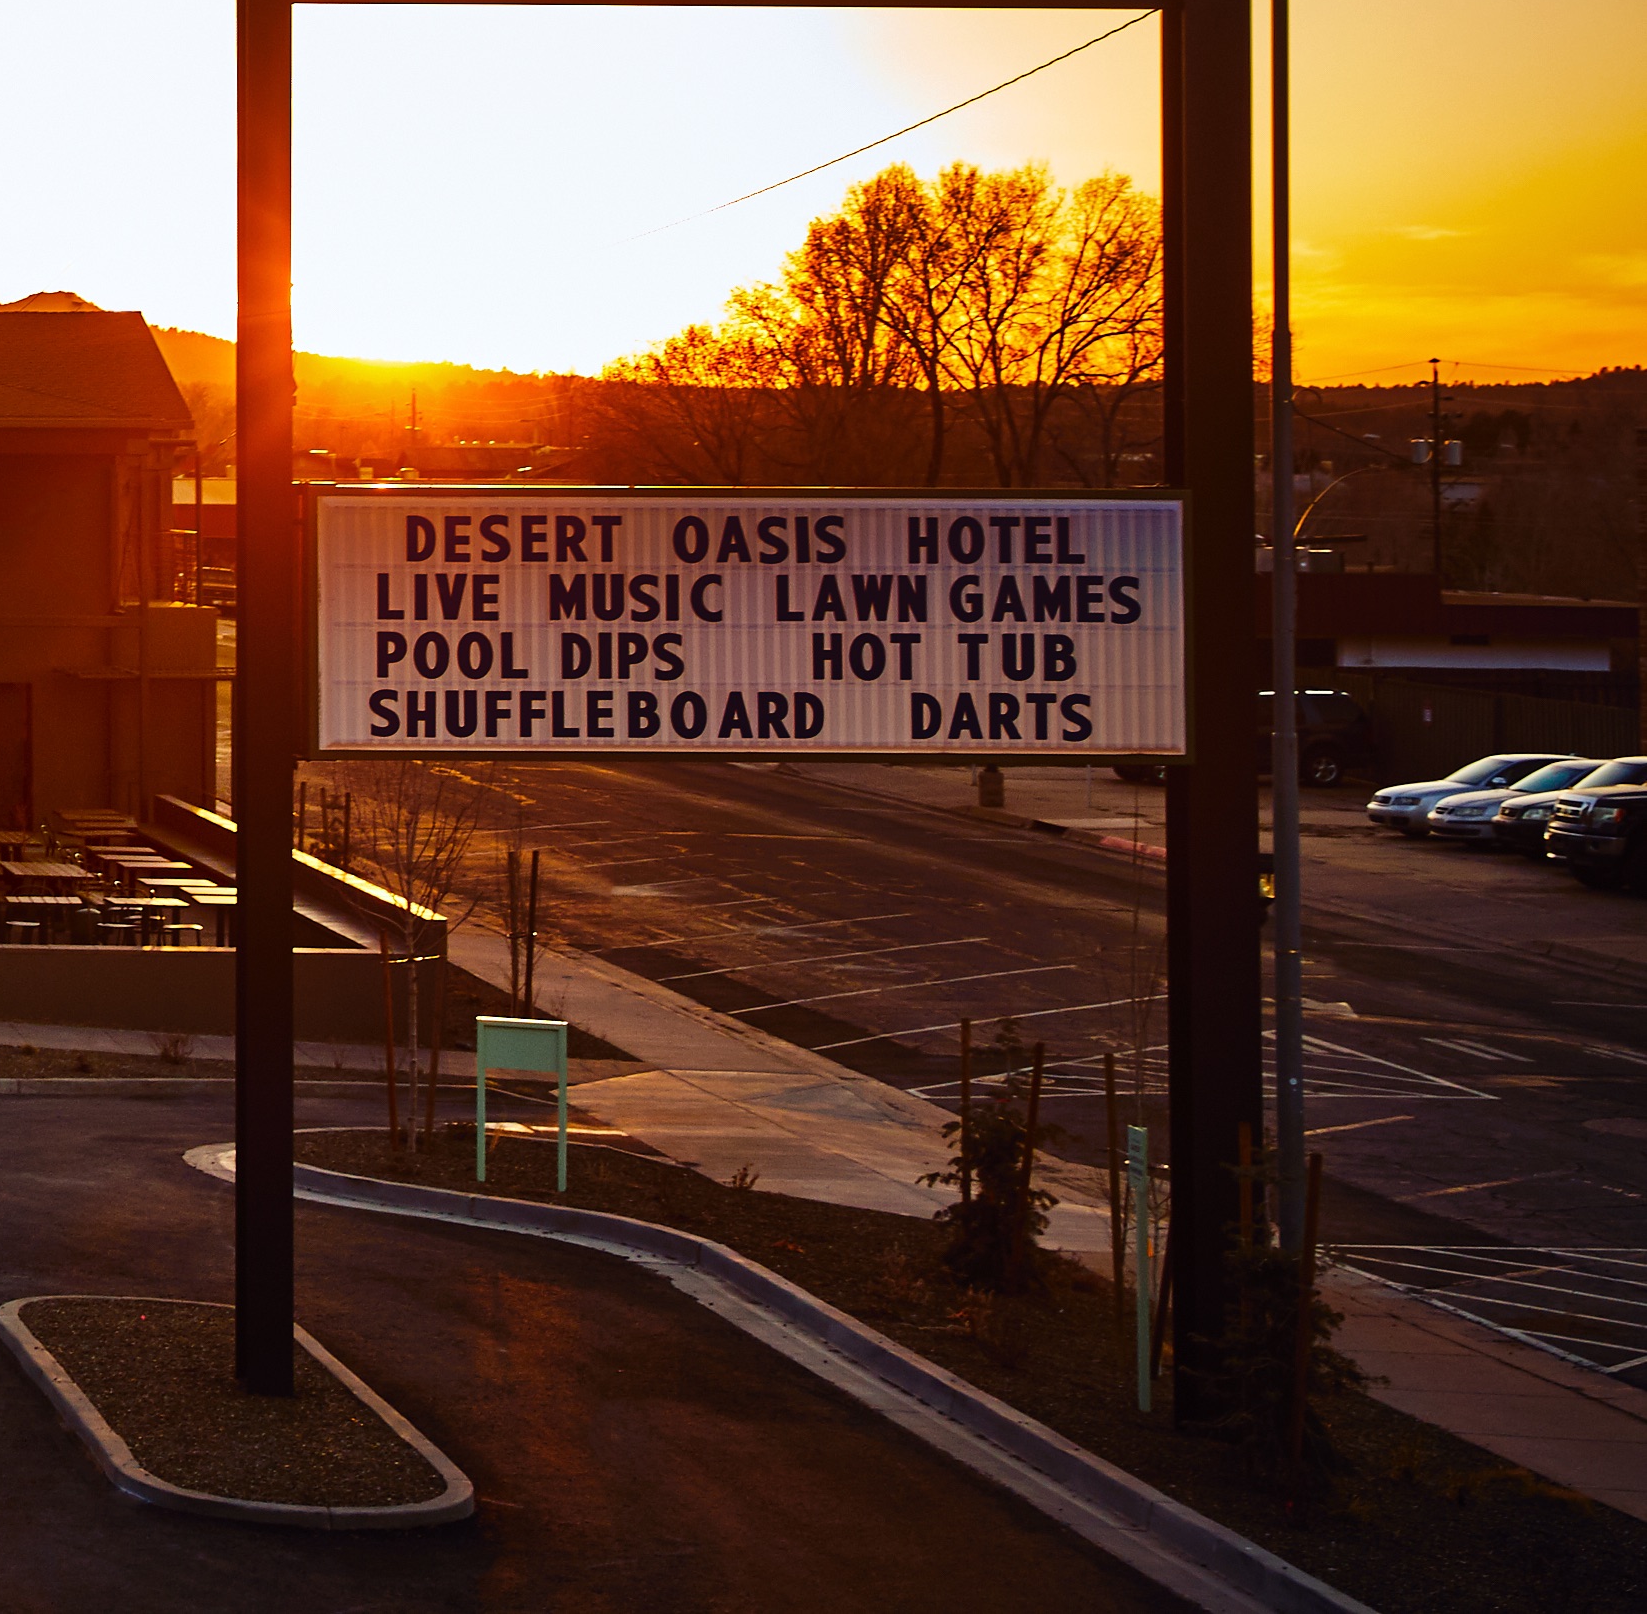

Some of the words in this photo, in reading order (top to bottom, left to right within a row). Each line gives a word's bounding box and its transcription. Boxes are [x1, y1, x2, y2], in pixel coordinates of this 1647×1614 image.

[405, 514, 623, 564] DESERT
[672, 514, 848, 564] OASIS
[907, 515, 1086, 565] HOTEL
[376, 572, 500, 622] LIVE
[548, 573, 724, 623] MUSIC
[775, 573, 928, 623] LAWN
[948, 574, 1142, 625] GAMES
[376, 631, 529, 680] POOL
[560, 631, 685, 682] DIPS
[811, 632, 922, 682] HOT
[957, 632, 1078, 682] TUB
[368, 688, 825, 740] SHUFFLEBOARD
[910, 692, 1093, 743] DARTS
